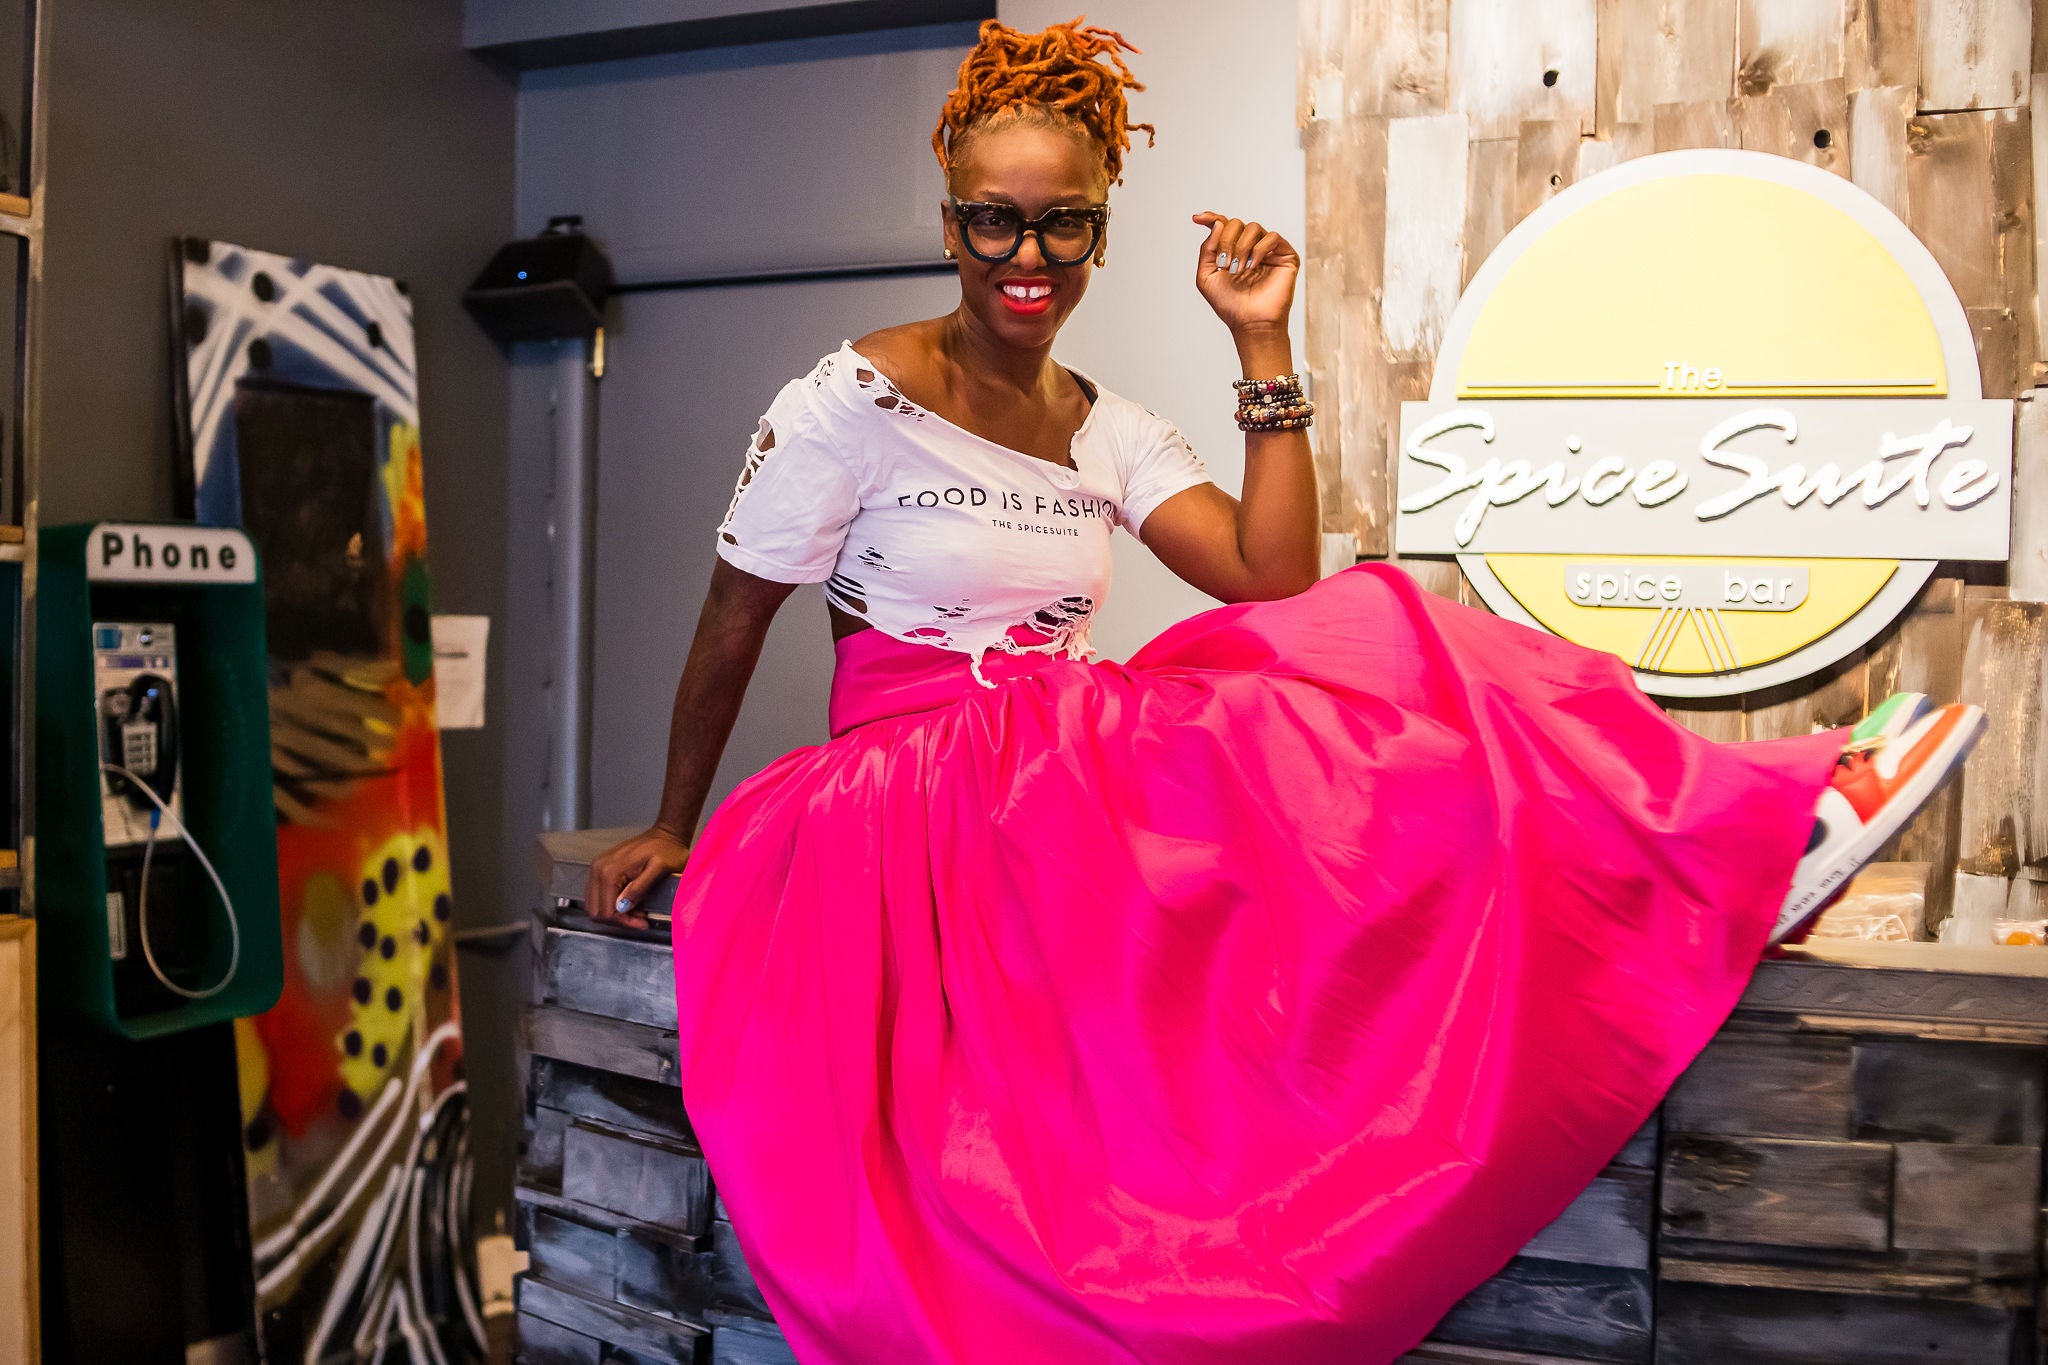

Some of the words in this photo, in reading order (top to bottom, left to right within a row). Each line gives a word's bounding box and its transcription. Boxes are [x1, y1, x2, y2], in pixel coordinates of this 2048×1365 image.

[1664, 361, 1723, 390] The
[1400, 408, 1689, 548] Spice
[1695, 408, 2000, 521] Suite
[898, 487, 987, 508] FOOD
[1002, 491, 1022, 511] IS
[992, 519, 1012, 530] THE
[1017, 523, 1079, 537] SPICESUITE
[102, 532, 236, 570] Phone
[1576, 568, 1682, 607] spice
[1724, 569, 1793, 604] bar
